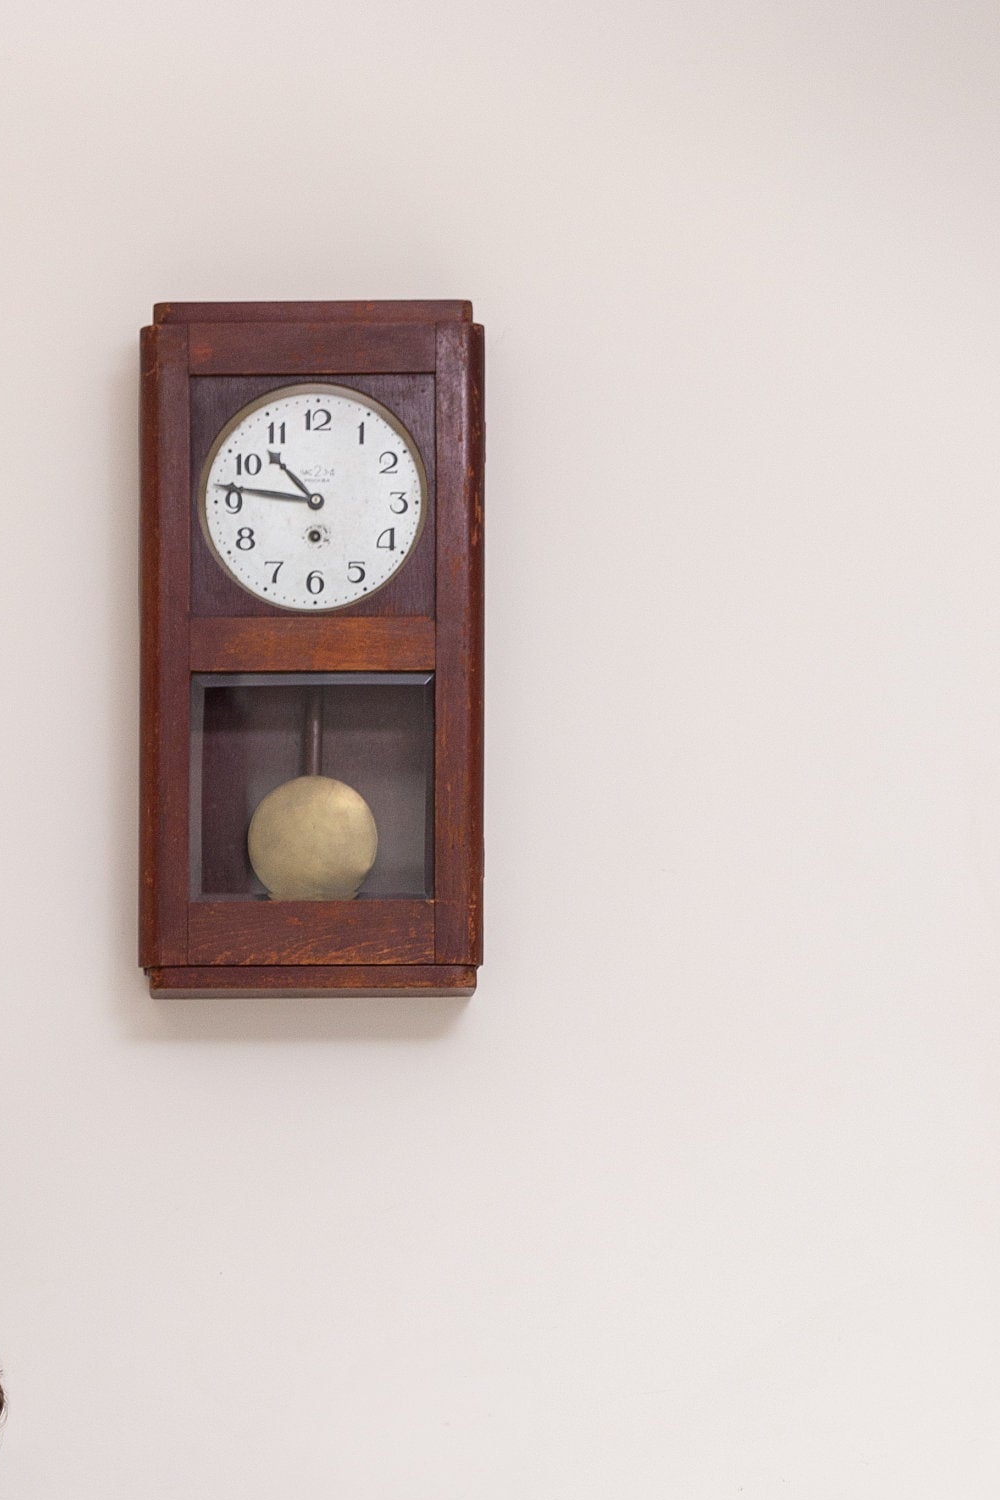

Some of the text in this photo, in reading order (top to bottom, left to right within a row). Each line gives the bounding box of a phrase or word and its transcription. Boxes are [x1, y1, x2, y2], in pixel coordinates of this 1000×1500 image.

[304, 409, 332, 431] 12
[267, 422, 286, 445] 11
[358, 422, 365, 445] 1
[235, 453, 262, 476] 10
[379, 451, 398, 474] 2
[225, 488, 243, 514] 9
[389, 491, 408, 514] 3
[235, 527, 256, 551] 8
[376, 527, 396, 551] 4
[264, 561, 284, 584] 7
[306, 571, 325, 595] 6
[347, 561, 366, 583] 5
